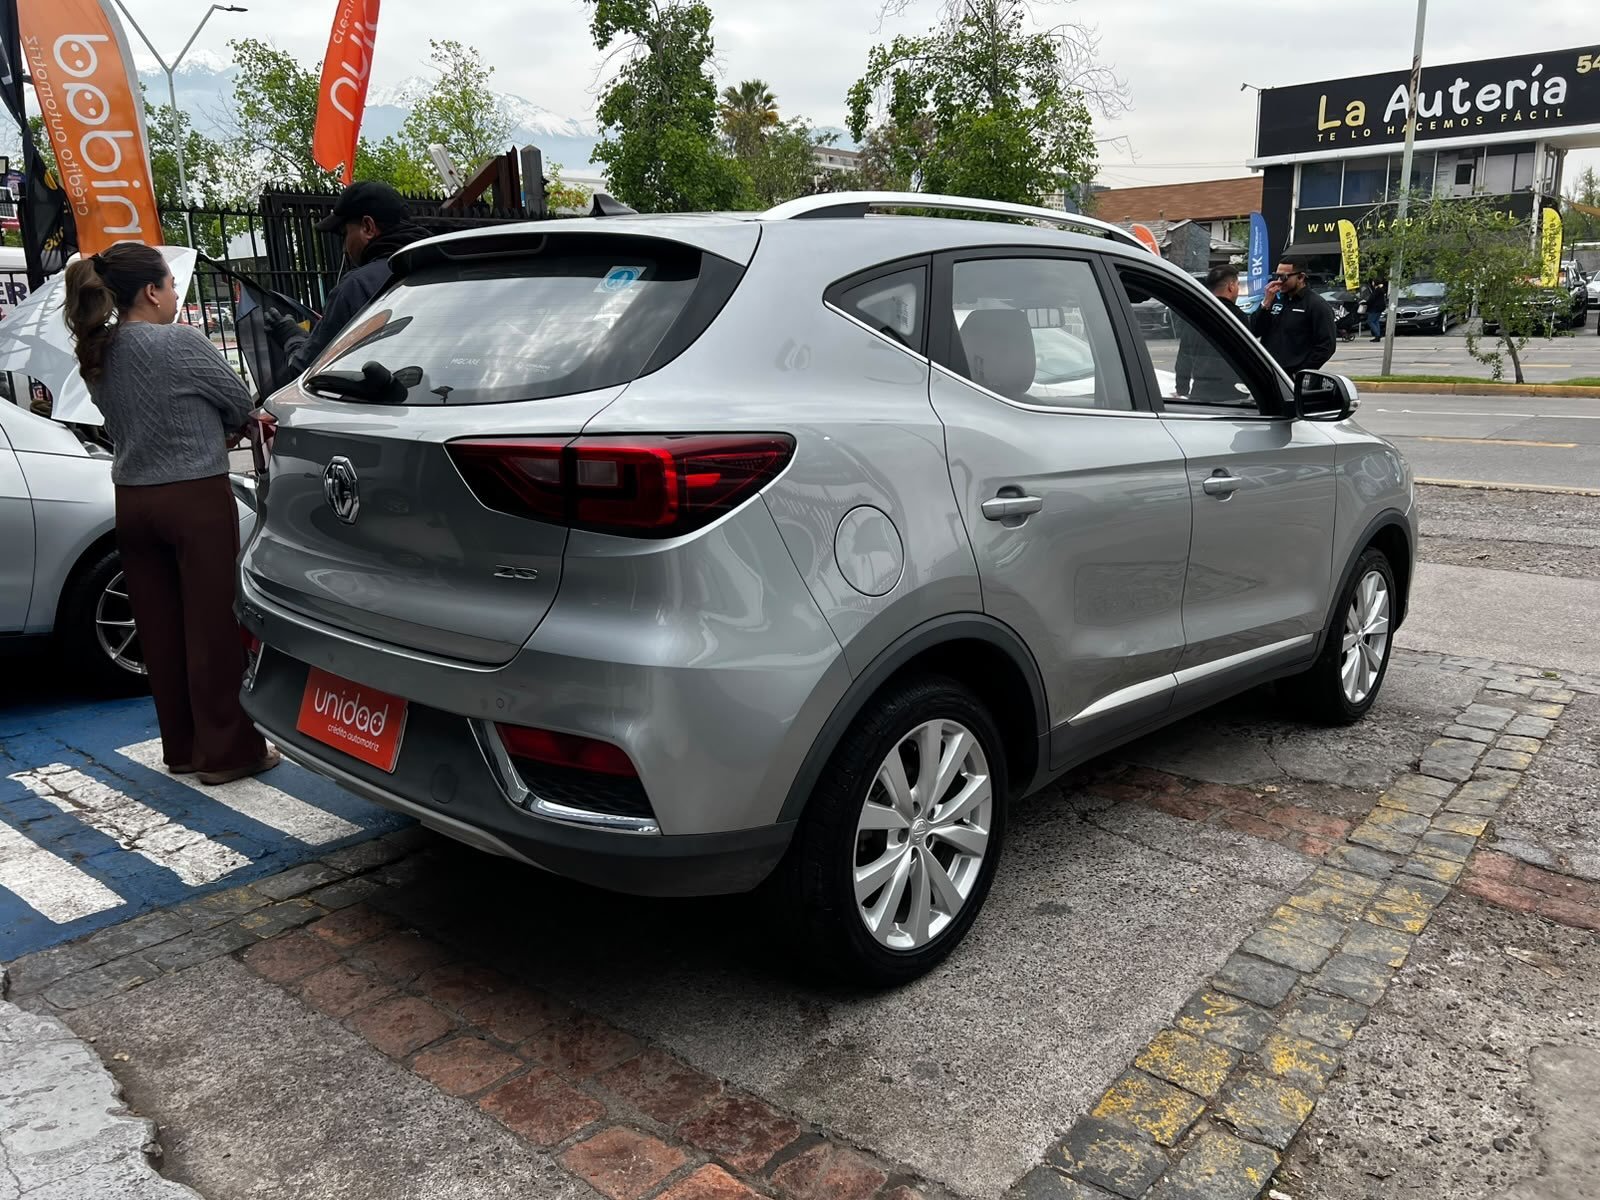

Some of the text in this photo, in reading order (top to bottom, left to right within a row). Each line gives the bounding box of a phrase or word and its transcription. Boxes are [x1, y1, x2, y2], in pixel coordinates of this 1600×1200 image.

[1317, 63, 1568, 131] La Autería
[1317, 107, 1564, 142] TE LO HACEMOS FÁCIL
[1252, 256, 1263, 276] BK
[493, 564, 538, 580] ZS
[314, 687, 389, 736] unidad
[327, 723, 380, 752] crédito automotriz
